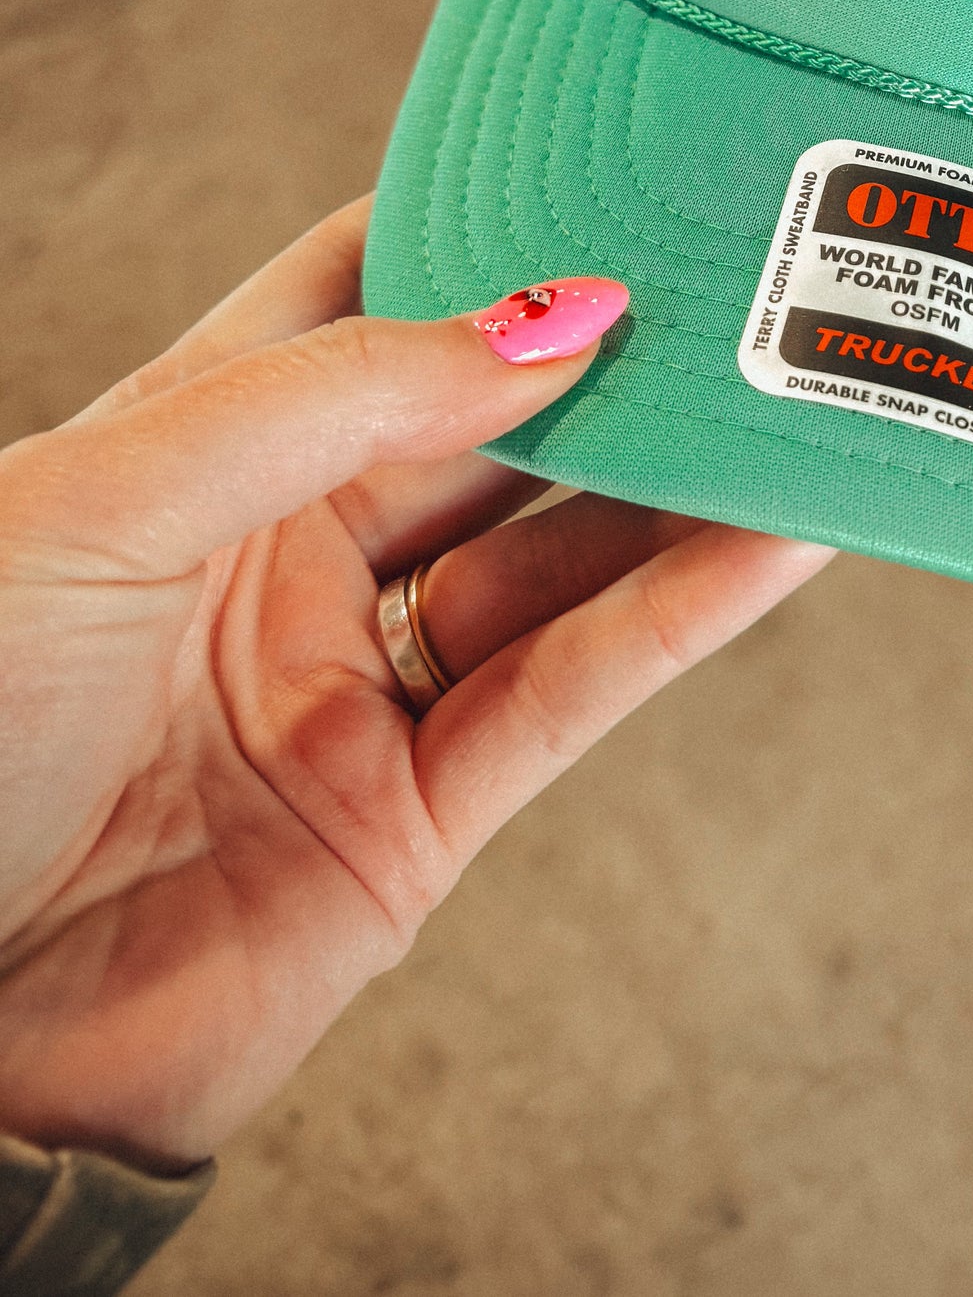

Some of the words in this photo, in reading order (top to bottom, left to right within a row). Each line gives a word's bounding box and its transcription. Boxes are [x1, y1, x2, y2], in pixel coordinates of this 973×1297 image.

[855, 148, 933, 174] PREMIUM
[752, 307, 778, 353] TERRY
[768, 259, 793, 304] CLOTH
[782, 170, 818, 256] SWEATBAND
[819, 244, 922, 276] WORLD
[835, 268, 919, 296] FOAM
[890, 300, 960, 332] OSFM
[786, 376, 870, 404] DURABLE
[876, 393, 929, 417] SNAP
